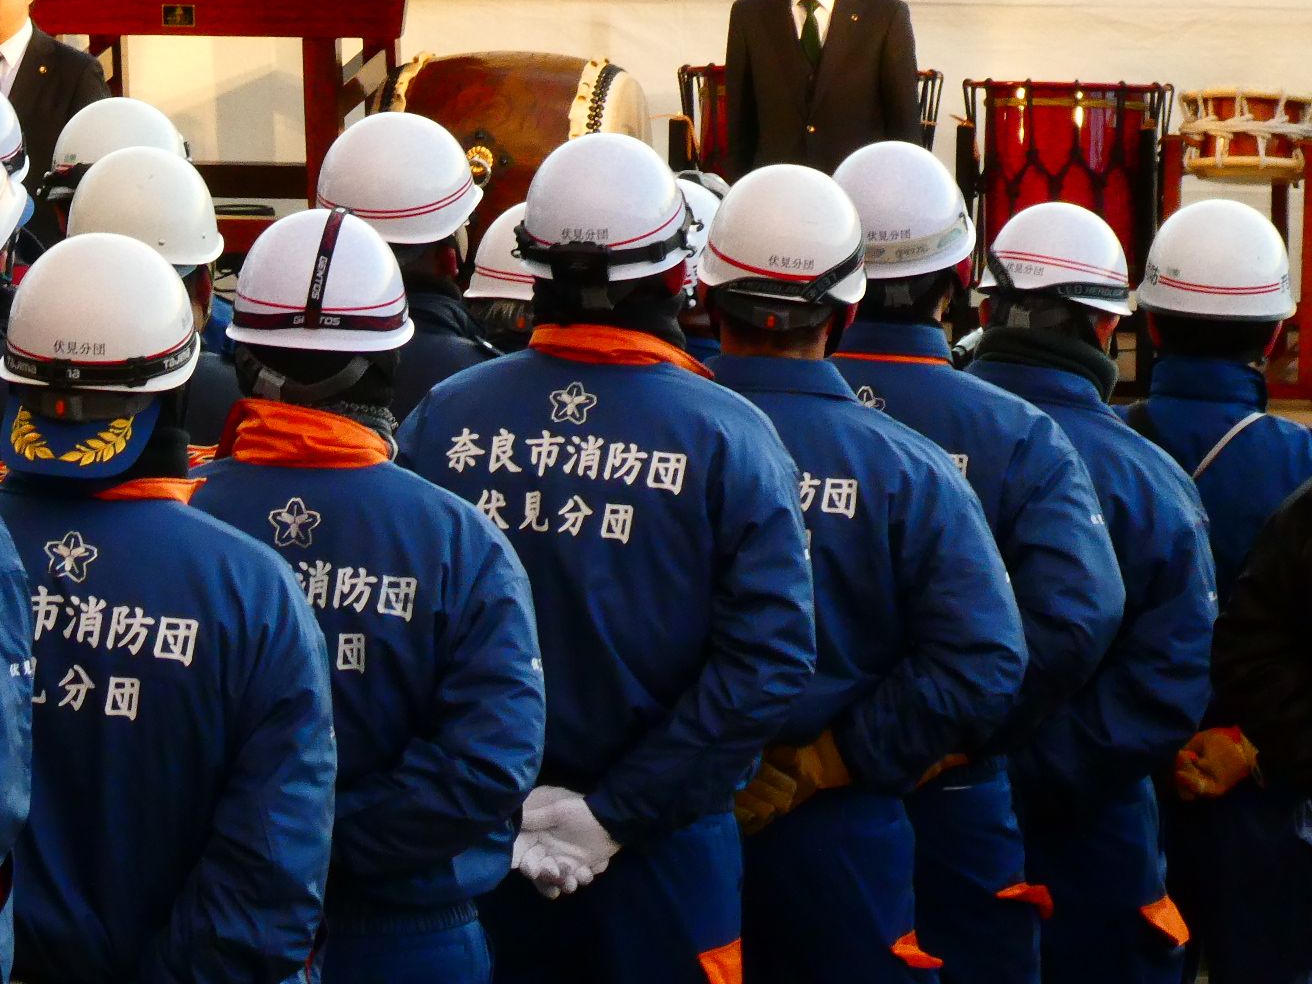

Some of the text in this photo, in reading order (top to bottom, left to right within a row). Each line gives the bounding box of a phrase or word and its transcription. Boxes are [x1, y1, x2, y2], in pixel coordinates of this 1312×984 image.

[768, 255, 815, 271] 伏見分団
[54, 339, 106, 357] 伏見分団
[445, 428, 687, 496] 奈良市消防団
[476, 489, 634, 544] 伏見分団
[336, 633, 366, 674] 団
